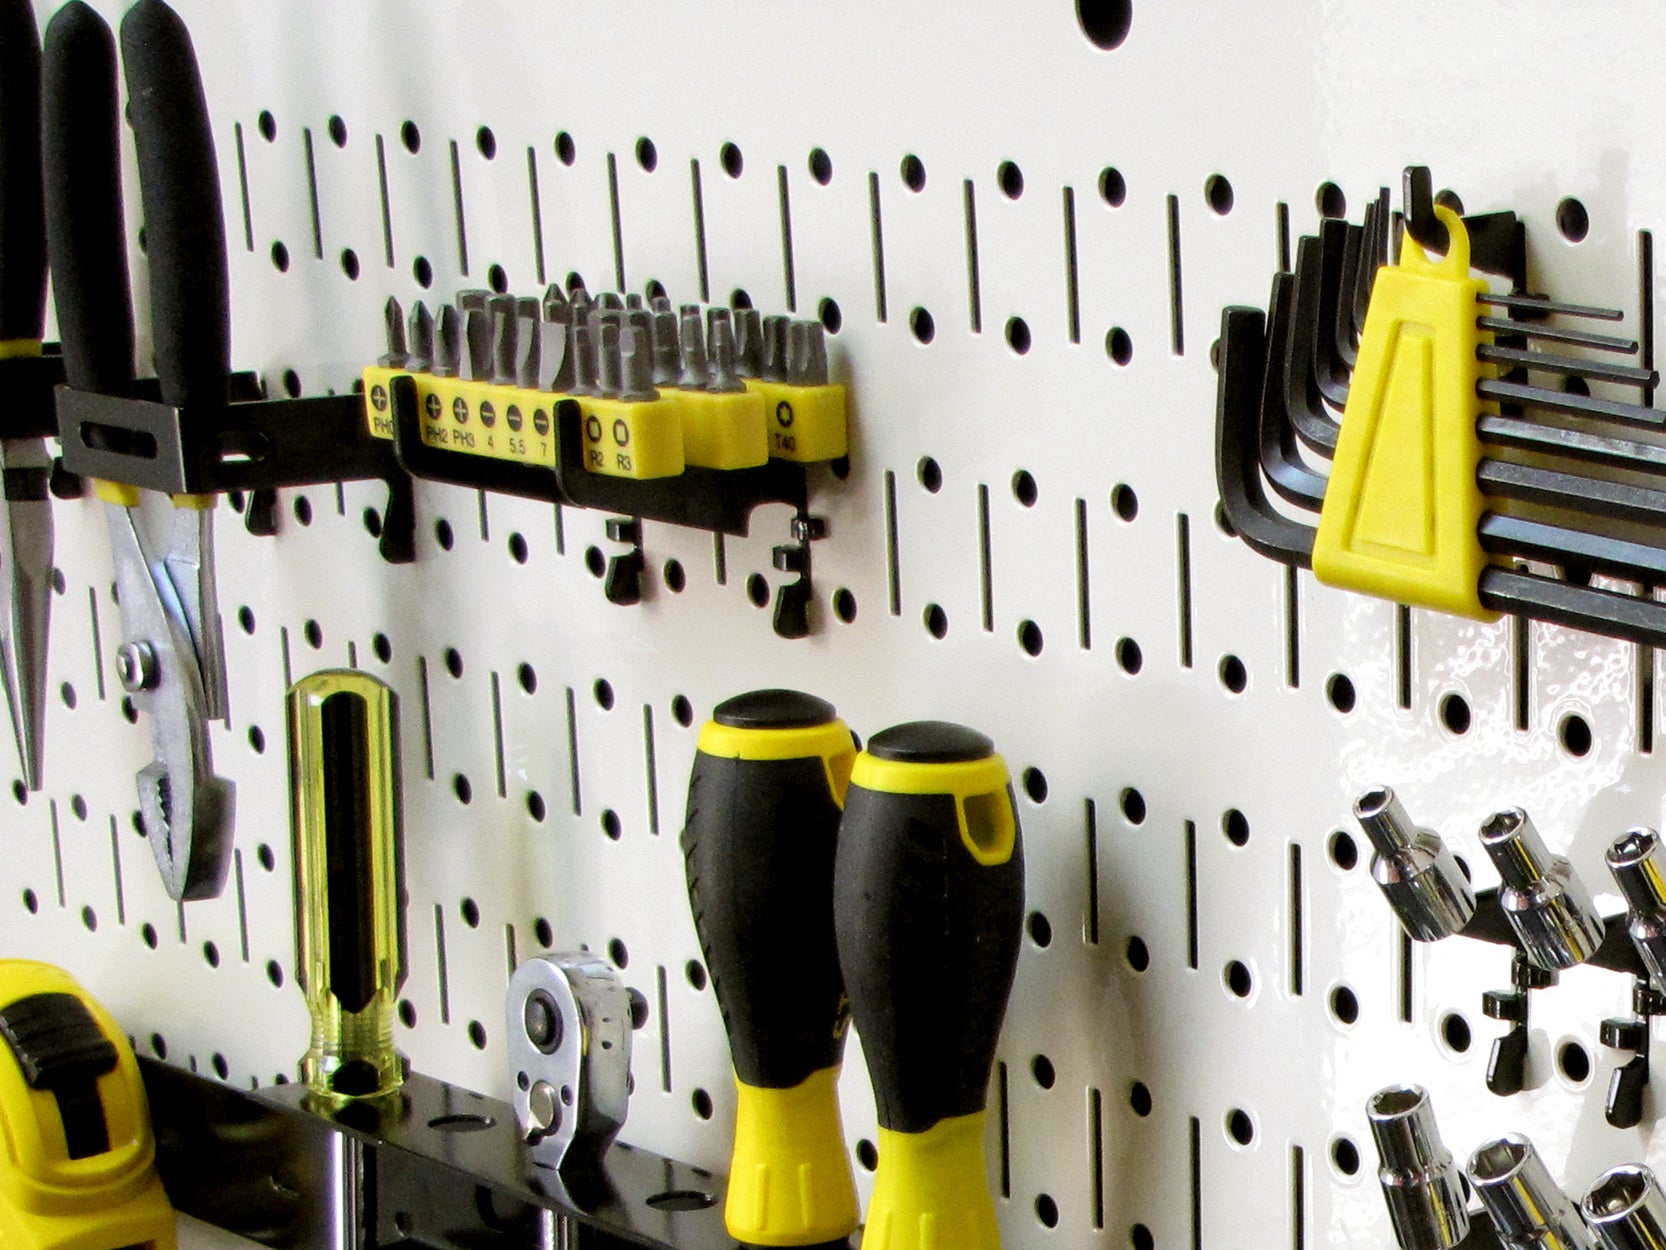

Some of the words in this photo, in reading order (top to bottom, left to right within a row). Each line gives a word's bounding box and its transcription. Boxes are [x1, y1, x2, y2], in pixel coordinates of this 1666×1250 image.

[425, 426, 448, 444] PH2
[452, 429, 475, 448] PH3
[487, 435, 495, 450] 4
[509, 438, 527, 454] 5.5
[540, 442, 548, 457] 7
[773, 433, 796, 452] T40
[590, 450, 605, 467] R2
[616, 453, 633, 471] R3
